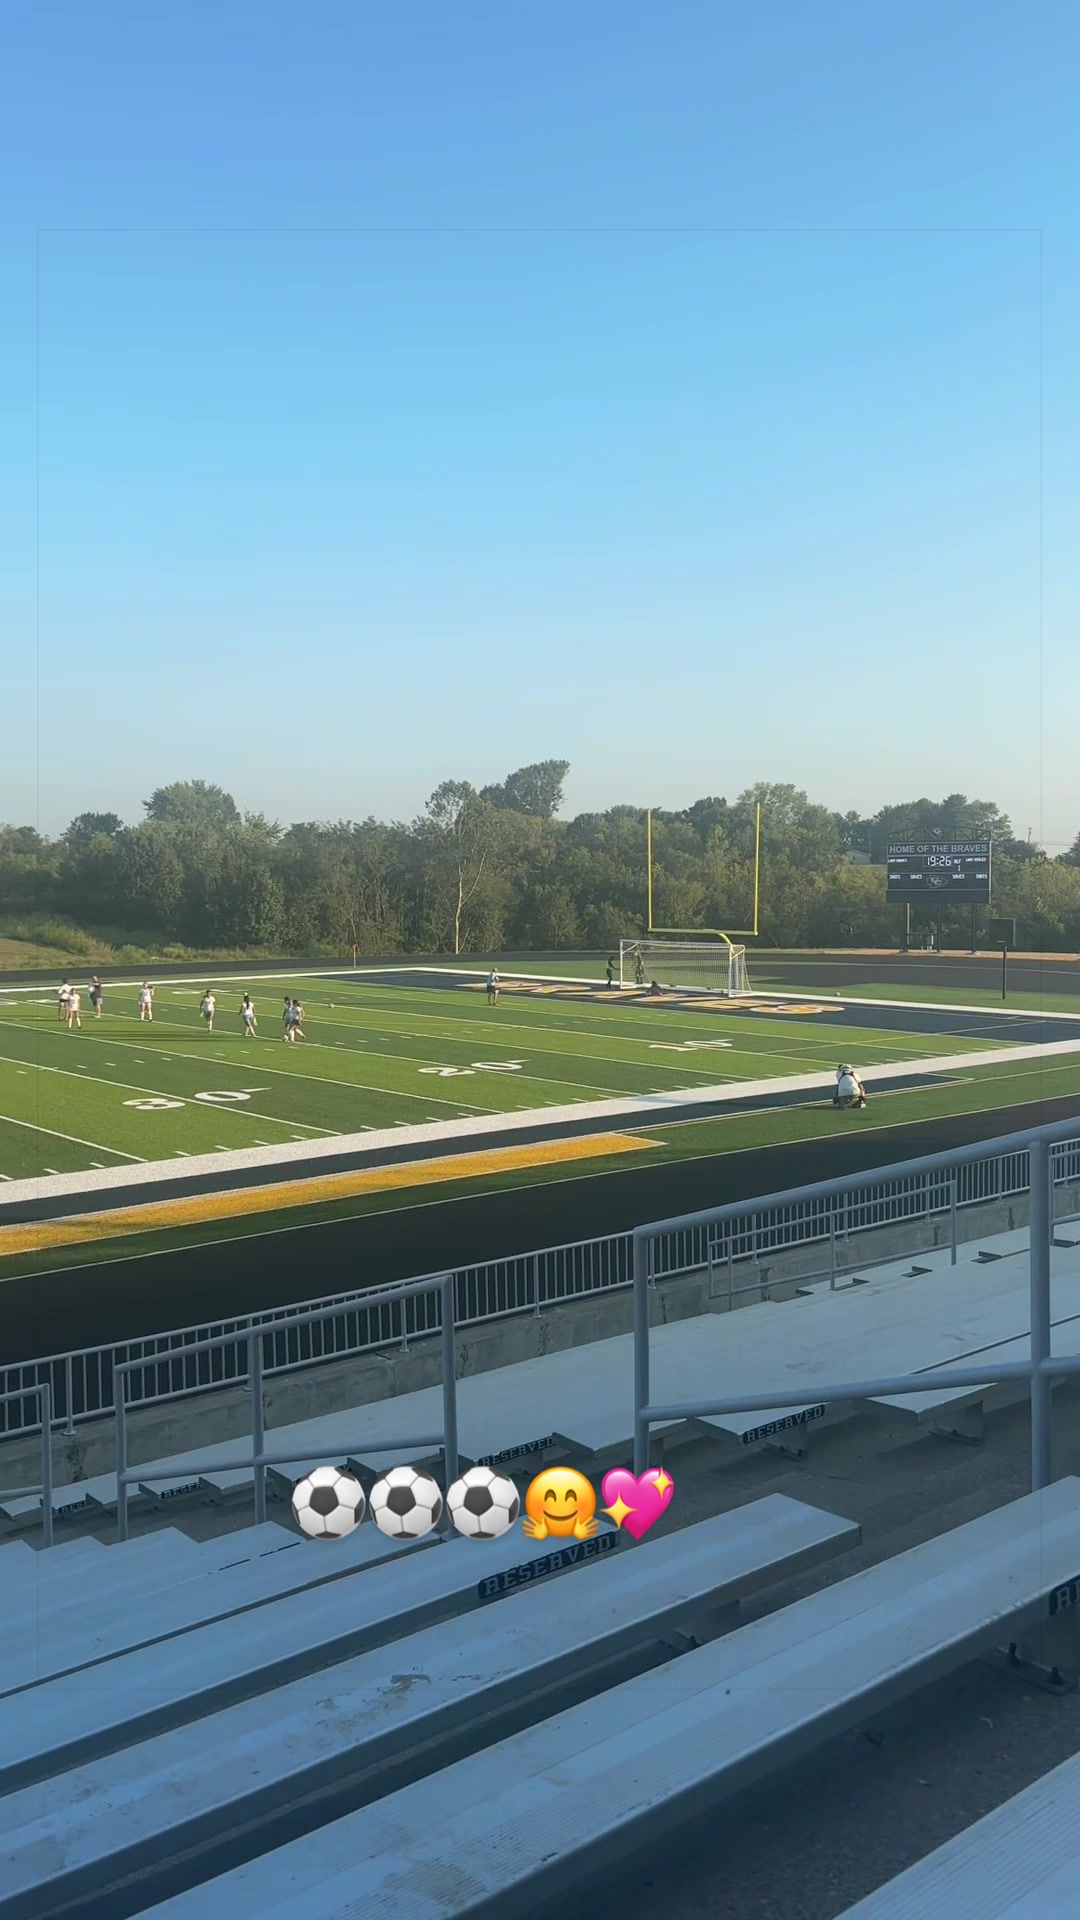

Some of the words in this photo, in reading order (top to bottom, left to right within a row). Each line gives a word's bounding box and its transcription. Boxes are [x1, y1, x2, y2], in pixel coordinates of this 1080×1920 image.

[889, 845, 915, 854] HOME
[917, 845, 929, 853] OF
[931, 845, 948, 853] THE
[951, 844, 988, 853] BRAVES
[927, 855, 952, 867] 19:26
[417, 1061, 523, 1077] 20
[122, 1090, 251, 1110] 30
[744, 1405, 825, 1442] RESERVED
[484, 1535, 612, 1595] RESERVED
